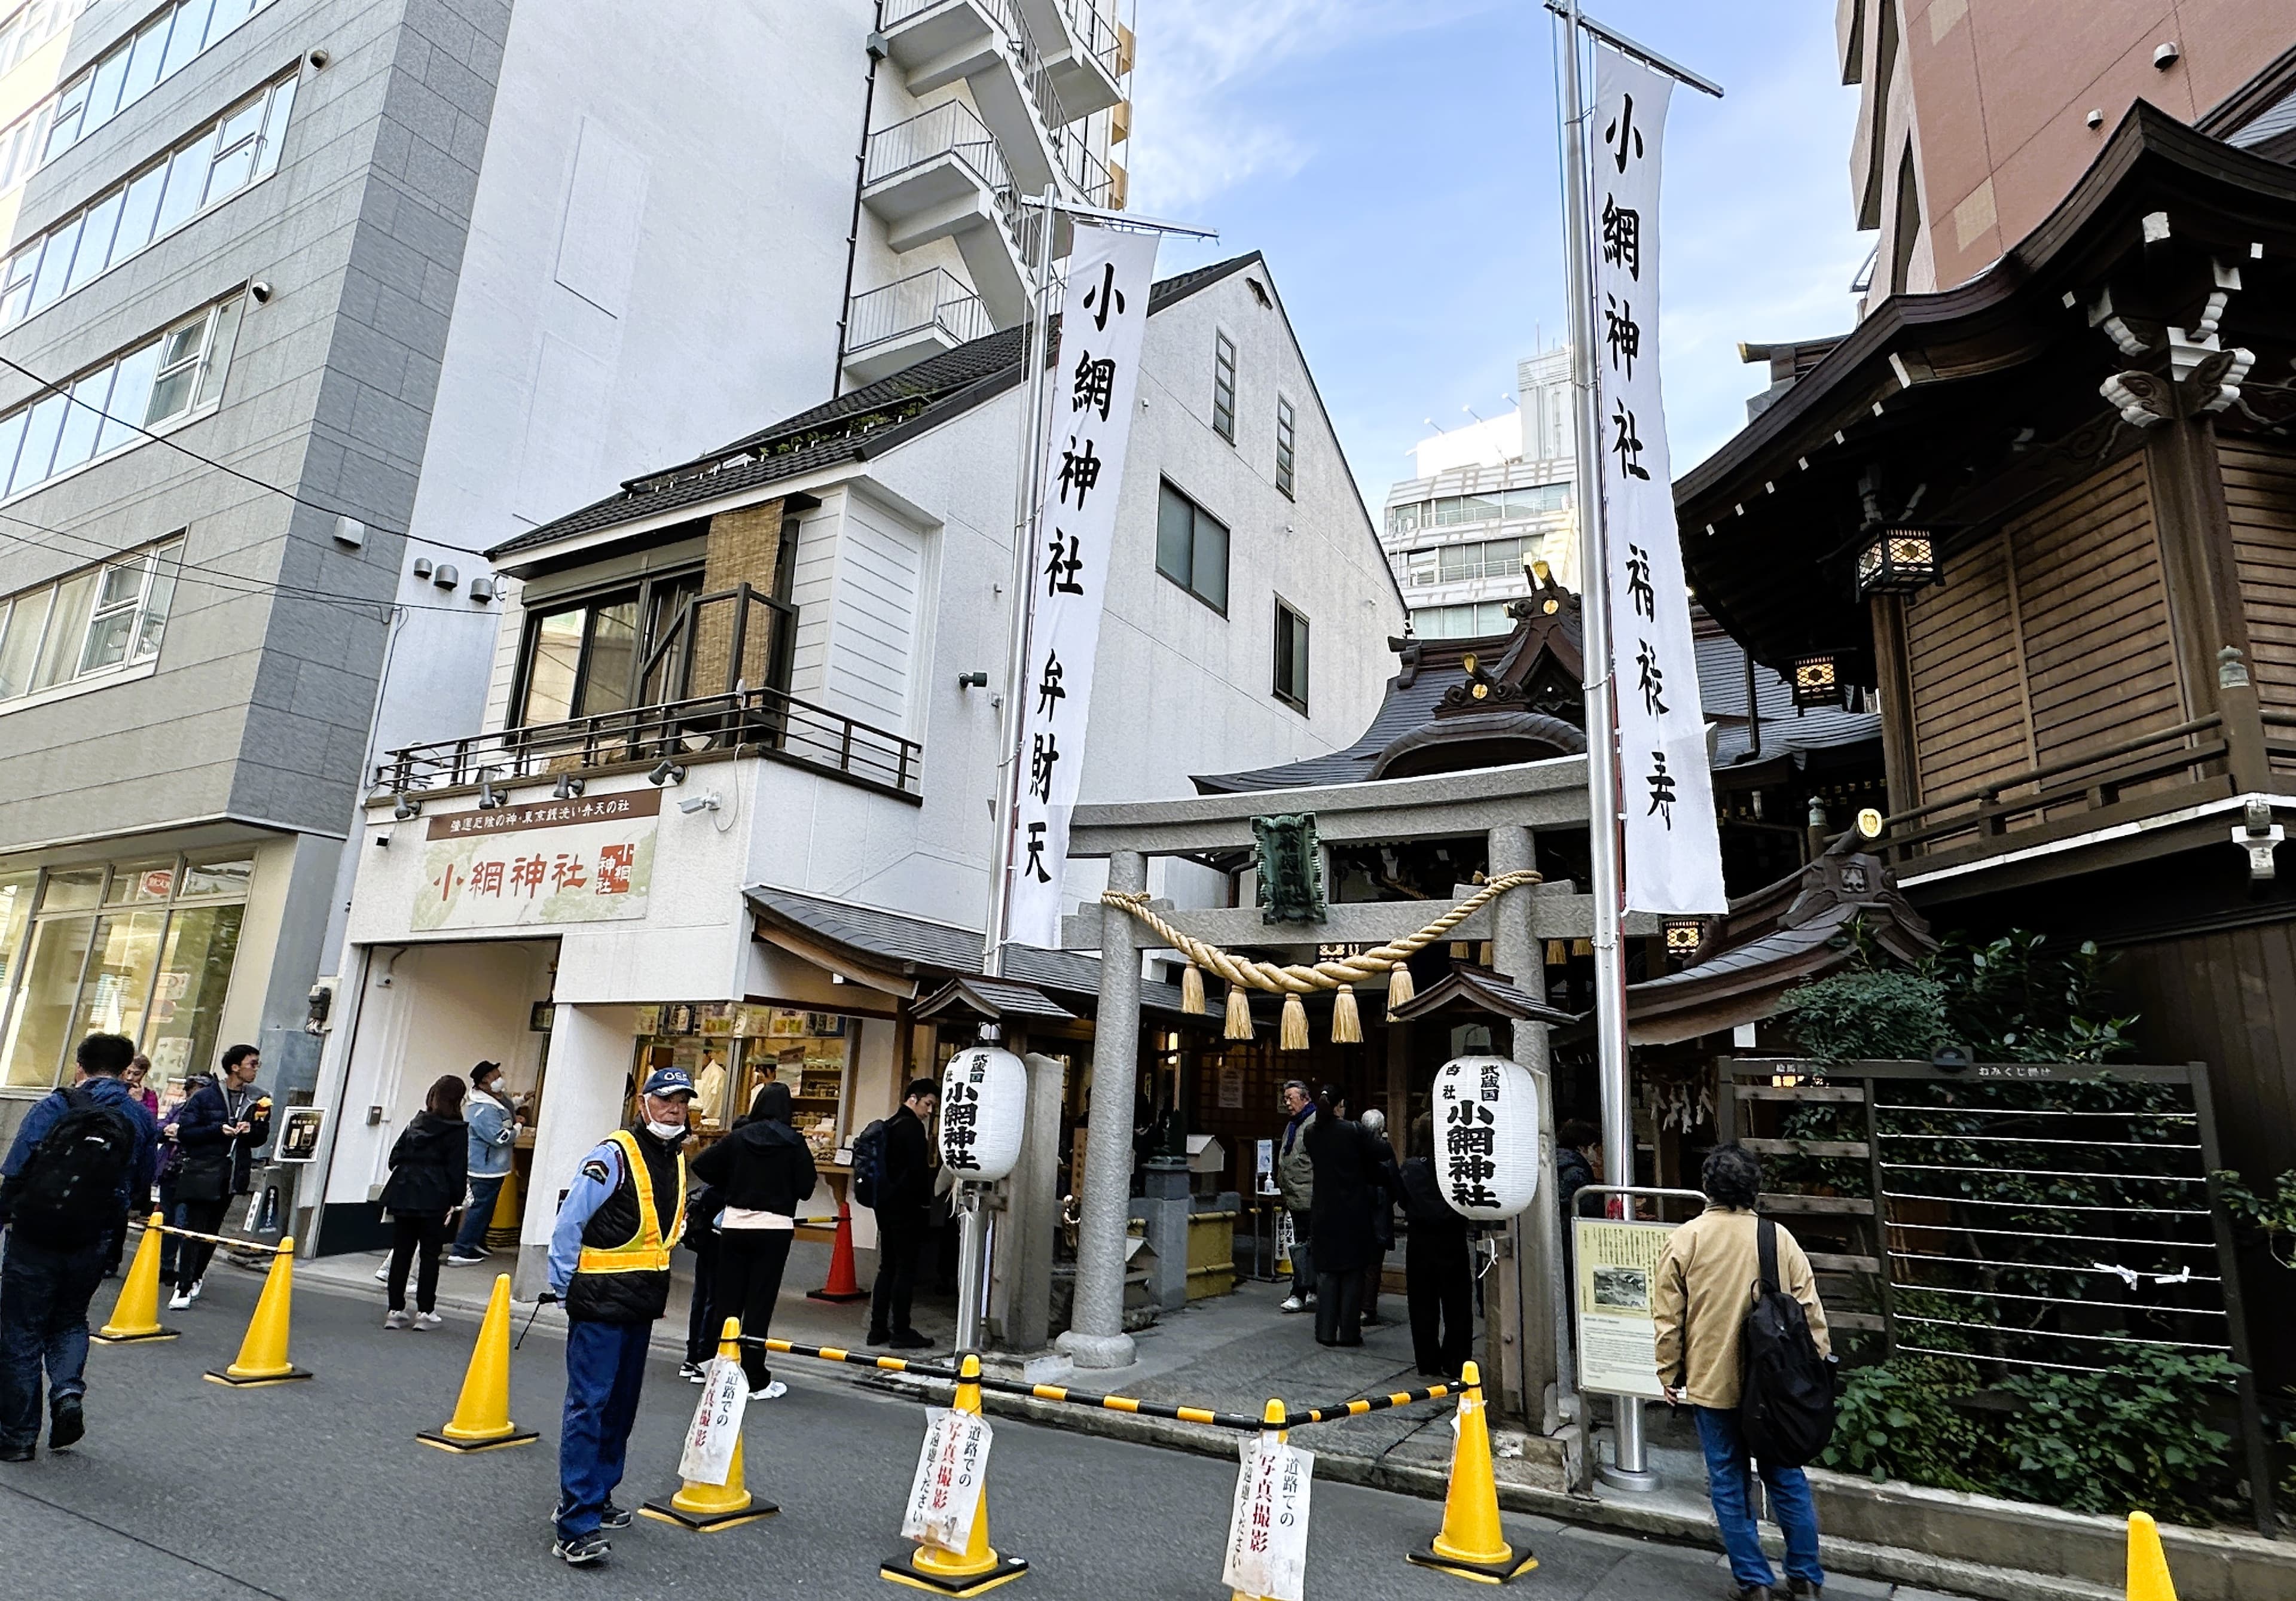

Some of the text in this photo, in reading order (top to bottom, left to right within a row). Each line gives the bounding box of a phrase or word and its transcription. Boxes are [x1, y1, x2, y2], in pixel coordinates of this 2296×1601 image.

[1602, 93, 1651, 481] 小網神社
[1025, 263, 1125, 884] 小網神社 弁財天
[433, 853, 588, 902] 小網神社
[944, 1082, 981, 1170] 小網神社
[1447, 1100, 1501, 1209] 小網神社
[716, 1370, 738, 1426] 道路での
[933, 1421, 963, 1509] 写真撮影
[958, 1425, 982, 1487] 道路での
[1280, 1457, 1300, 1527] 道路での
[1250, 1454, 1277, 1553] 写真撮影
